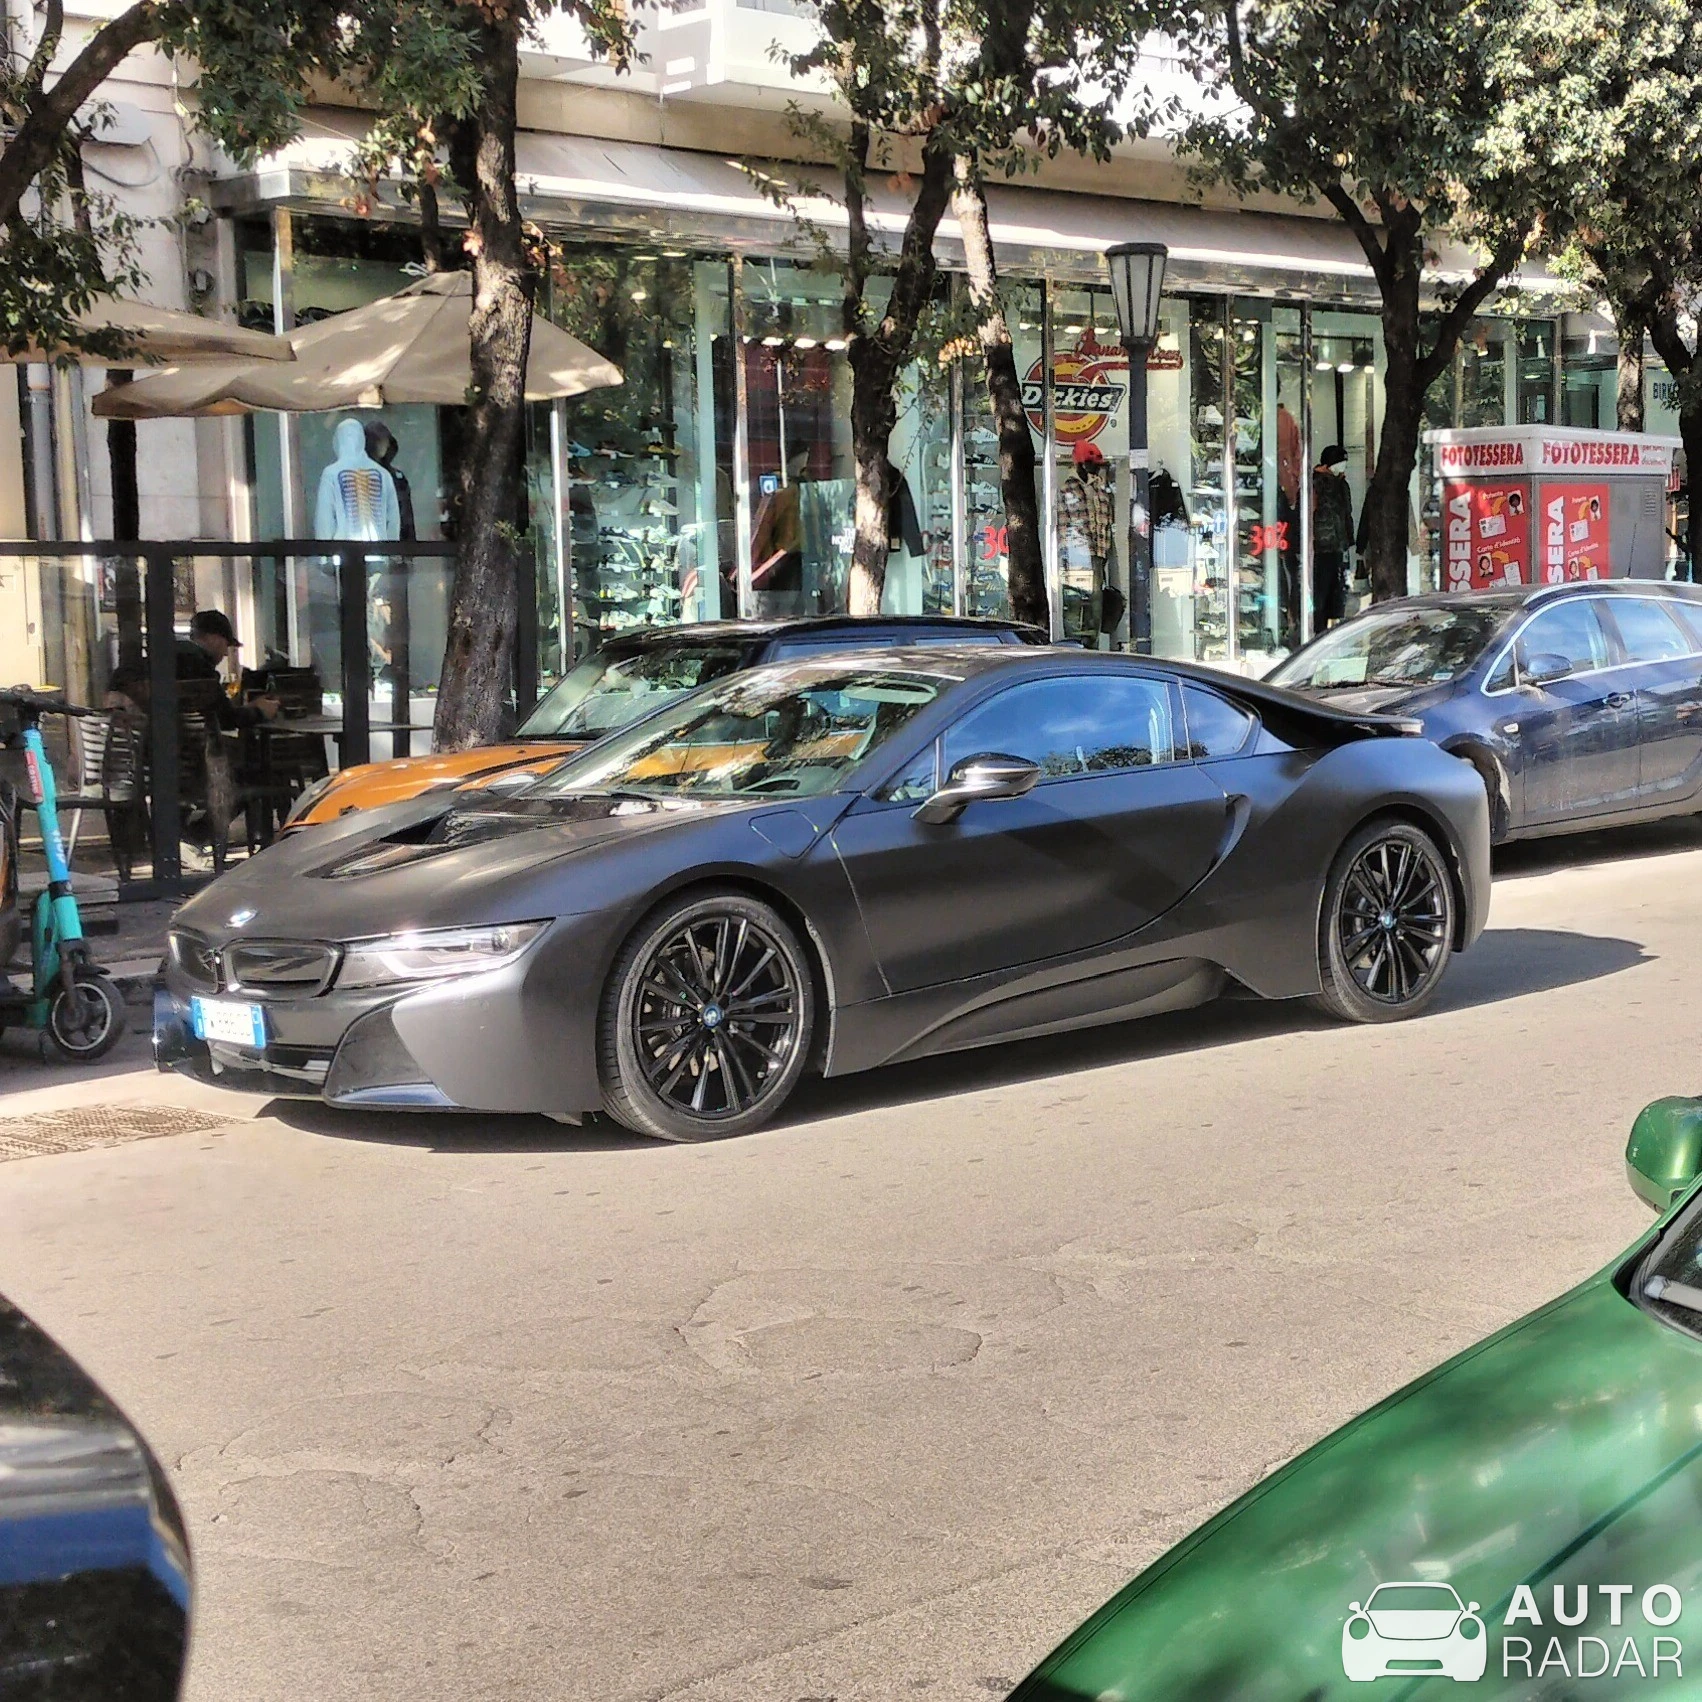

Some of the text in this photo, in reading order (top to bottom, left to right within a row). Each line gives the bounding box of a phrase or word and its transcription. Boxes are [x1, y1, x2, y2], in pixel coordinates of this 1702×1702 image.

[1021, 386, 1114, 408] Dckies
[1441, 443, 1524, 466] FOTOTESSERA
[1541, 442, 1640, 465] FOTOTESSERA
[1250, 521, 1290, 556] 30%
